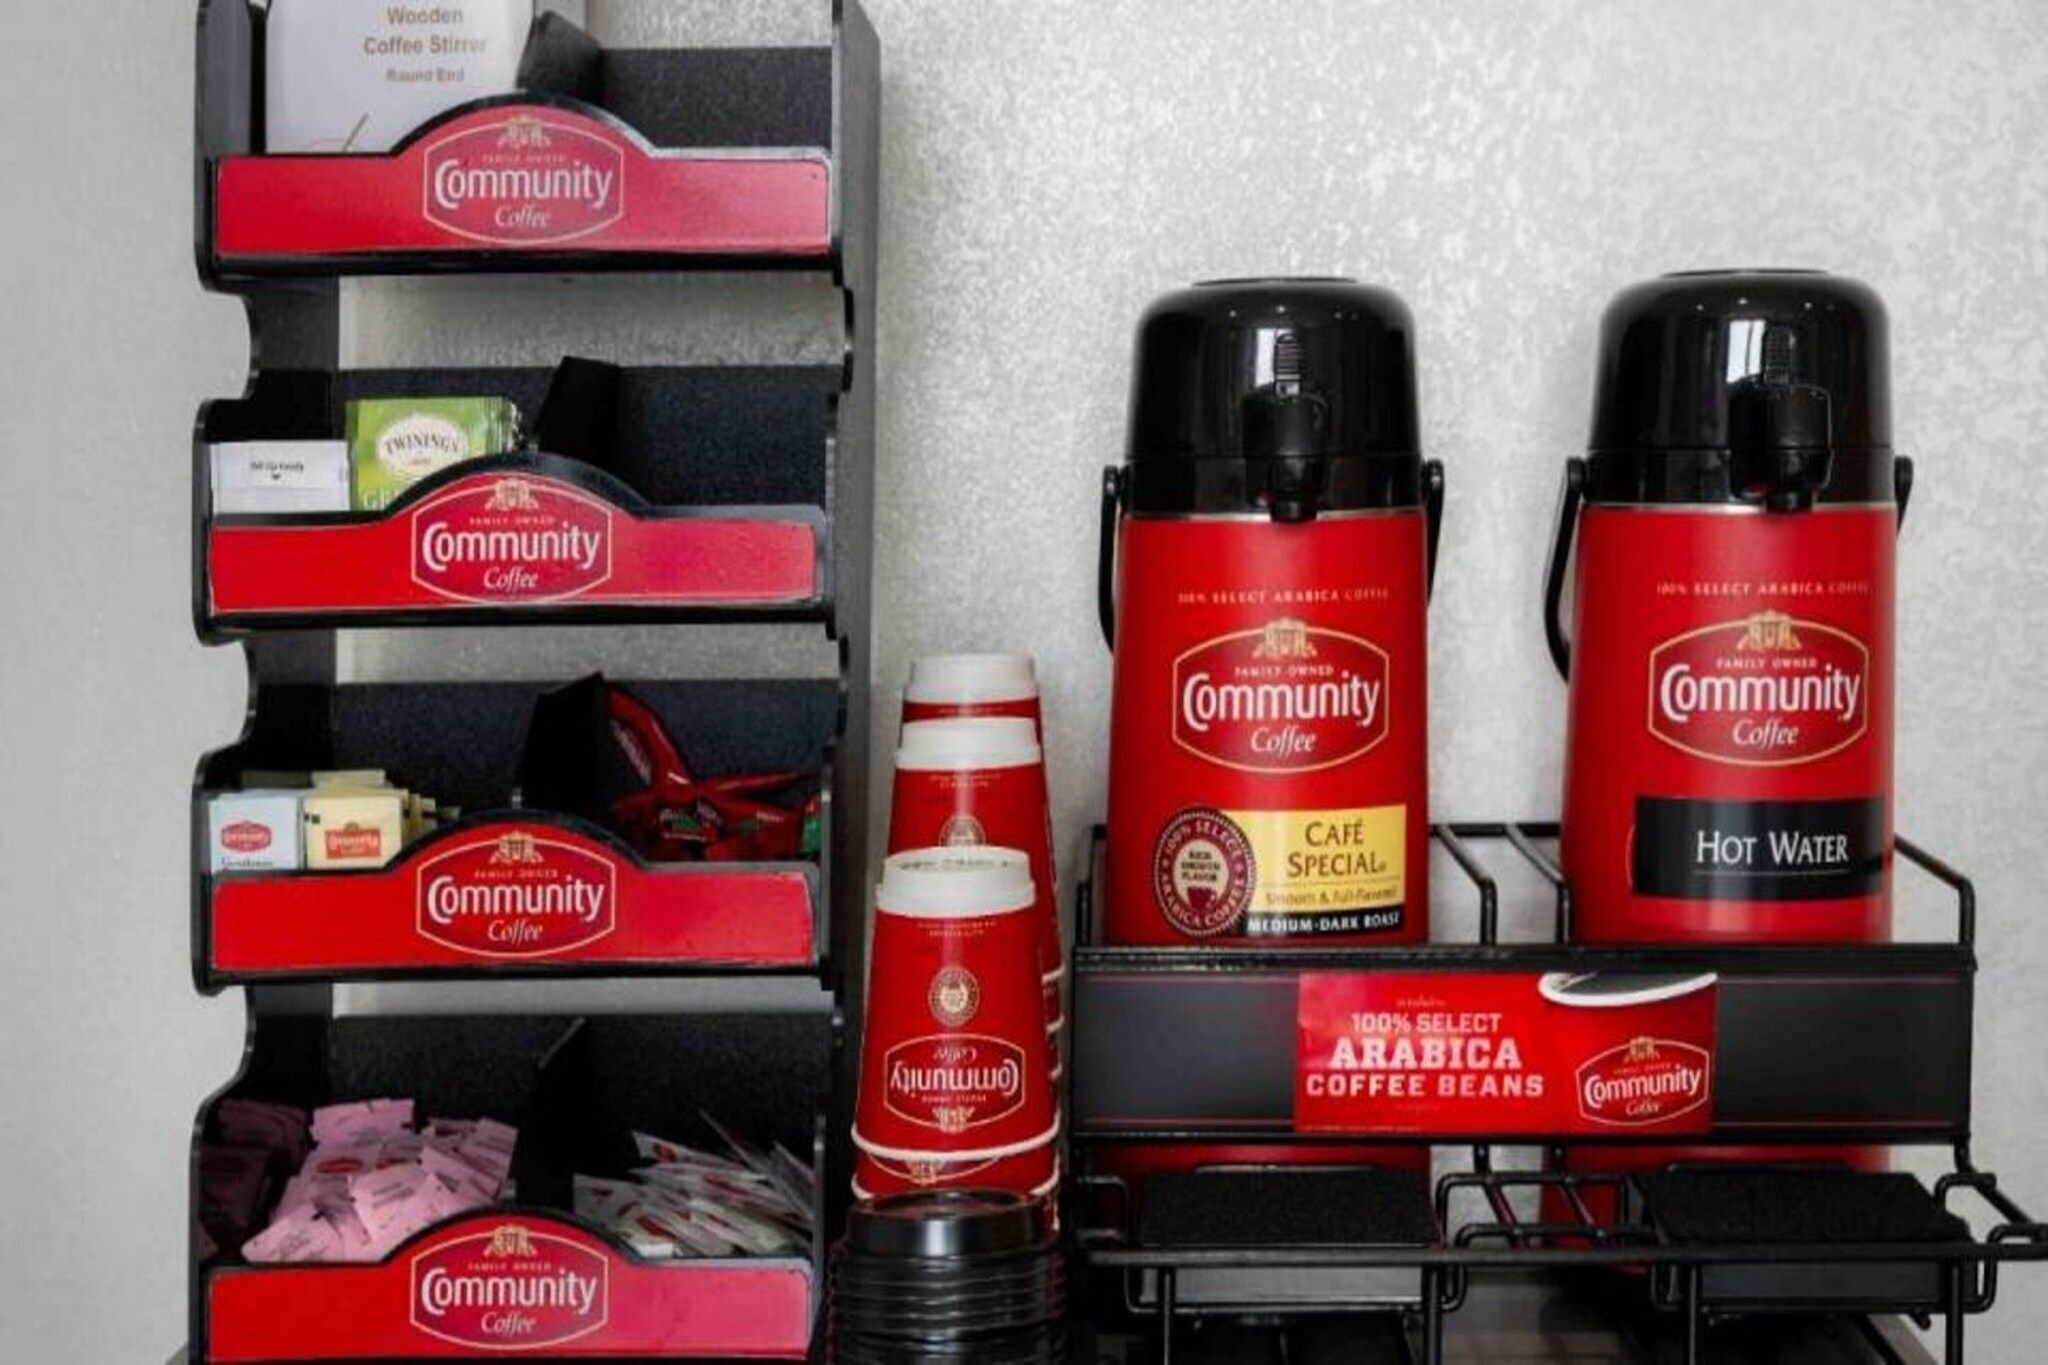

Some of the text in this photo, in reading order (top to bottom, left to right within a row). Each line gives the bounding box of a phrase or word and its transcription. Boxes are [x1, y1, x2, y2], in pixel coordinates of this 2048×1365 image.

[387, 6, 464, 24] Wooden
[364, 36, 423, 54] Coffee
[434, 158, 613, 210] Community
[495, 204, 549, 230] Coffee
[422, 521, 600, 572] Community
[483, 566, 539, 593] Coffee
[1693, 581, 1750, 596] SELECT
[1757, 581, 1824, 595] ARABICA
[1212, 589, 1265, 604] SELECT
[1273, 588, 1339, 603] ARABICA
[1233, 665, 1334, 677] FAMILY OWNED
[1716, 657, 1765, 669] FAMILY
[1182, 670, 1381, 732] Community
[1660, 661, 1861, 722] Community
[1249, 725, 1317, 757] Coffee
[1732, 717, 1799, 749] Coffee
[1304, 817, 1364, 847] CAFÉ
[427, 874, 605, 924] Community
[487, 918, 543, 946] Coffee
[1364, 911, 1400, 927] ROAST
[1351, 1012, 1502, 1034] 100% SELECT
[1329, 1036, 1523, 1071] ARABICA
[890, 1058, 1020, 1098] Community
[1305, 1073, 1545, 1098] COFFEE BEANS
[1584, 1063, 1702, 1110] Community
[421, 1266, 597, 1315] Community
[481, 1311, 536, 1337] Coffee
